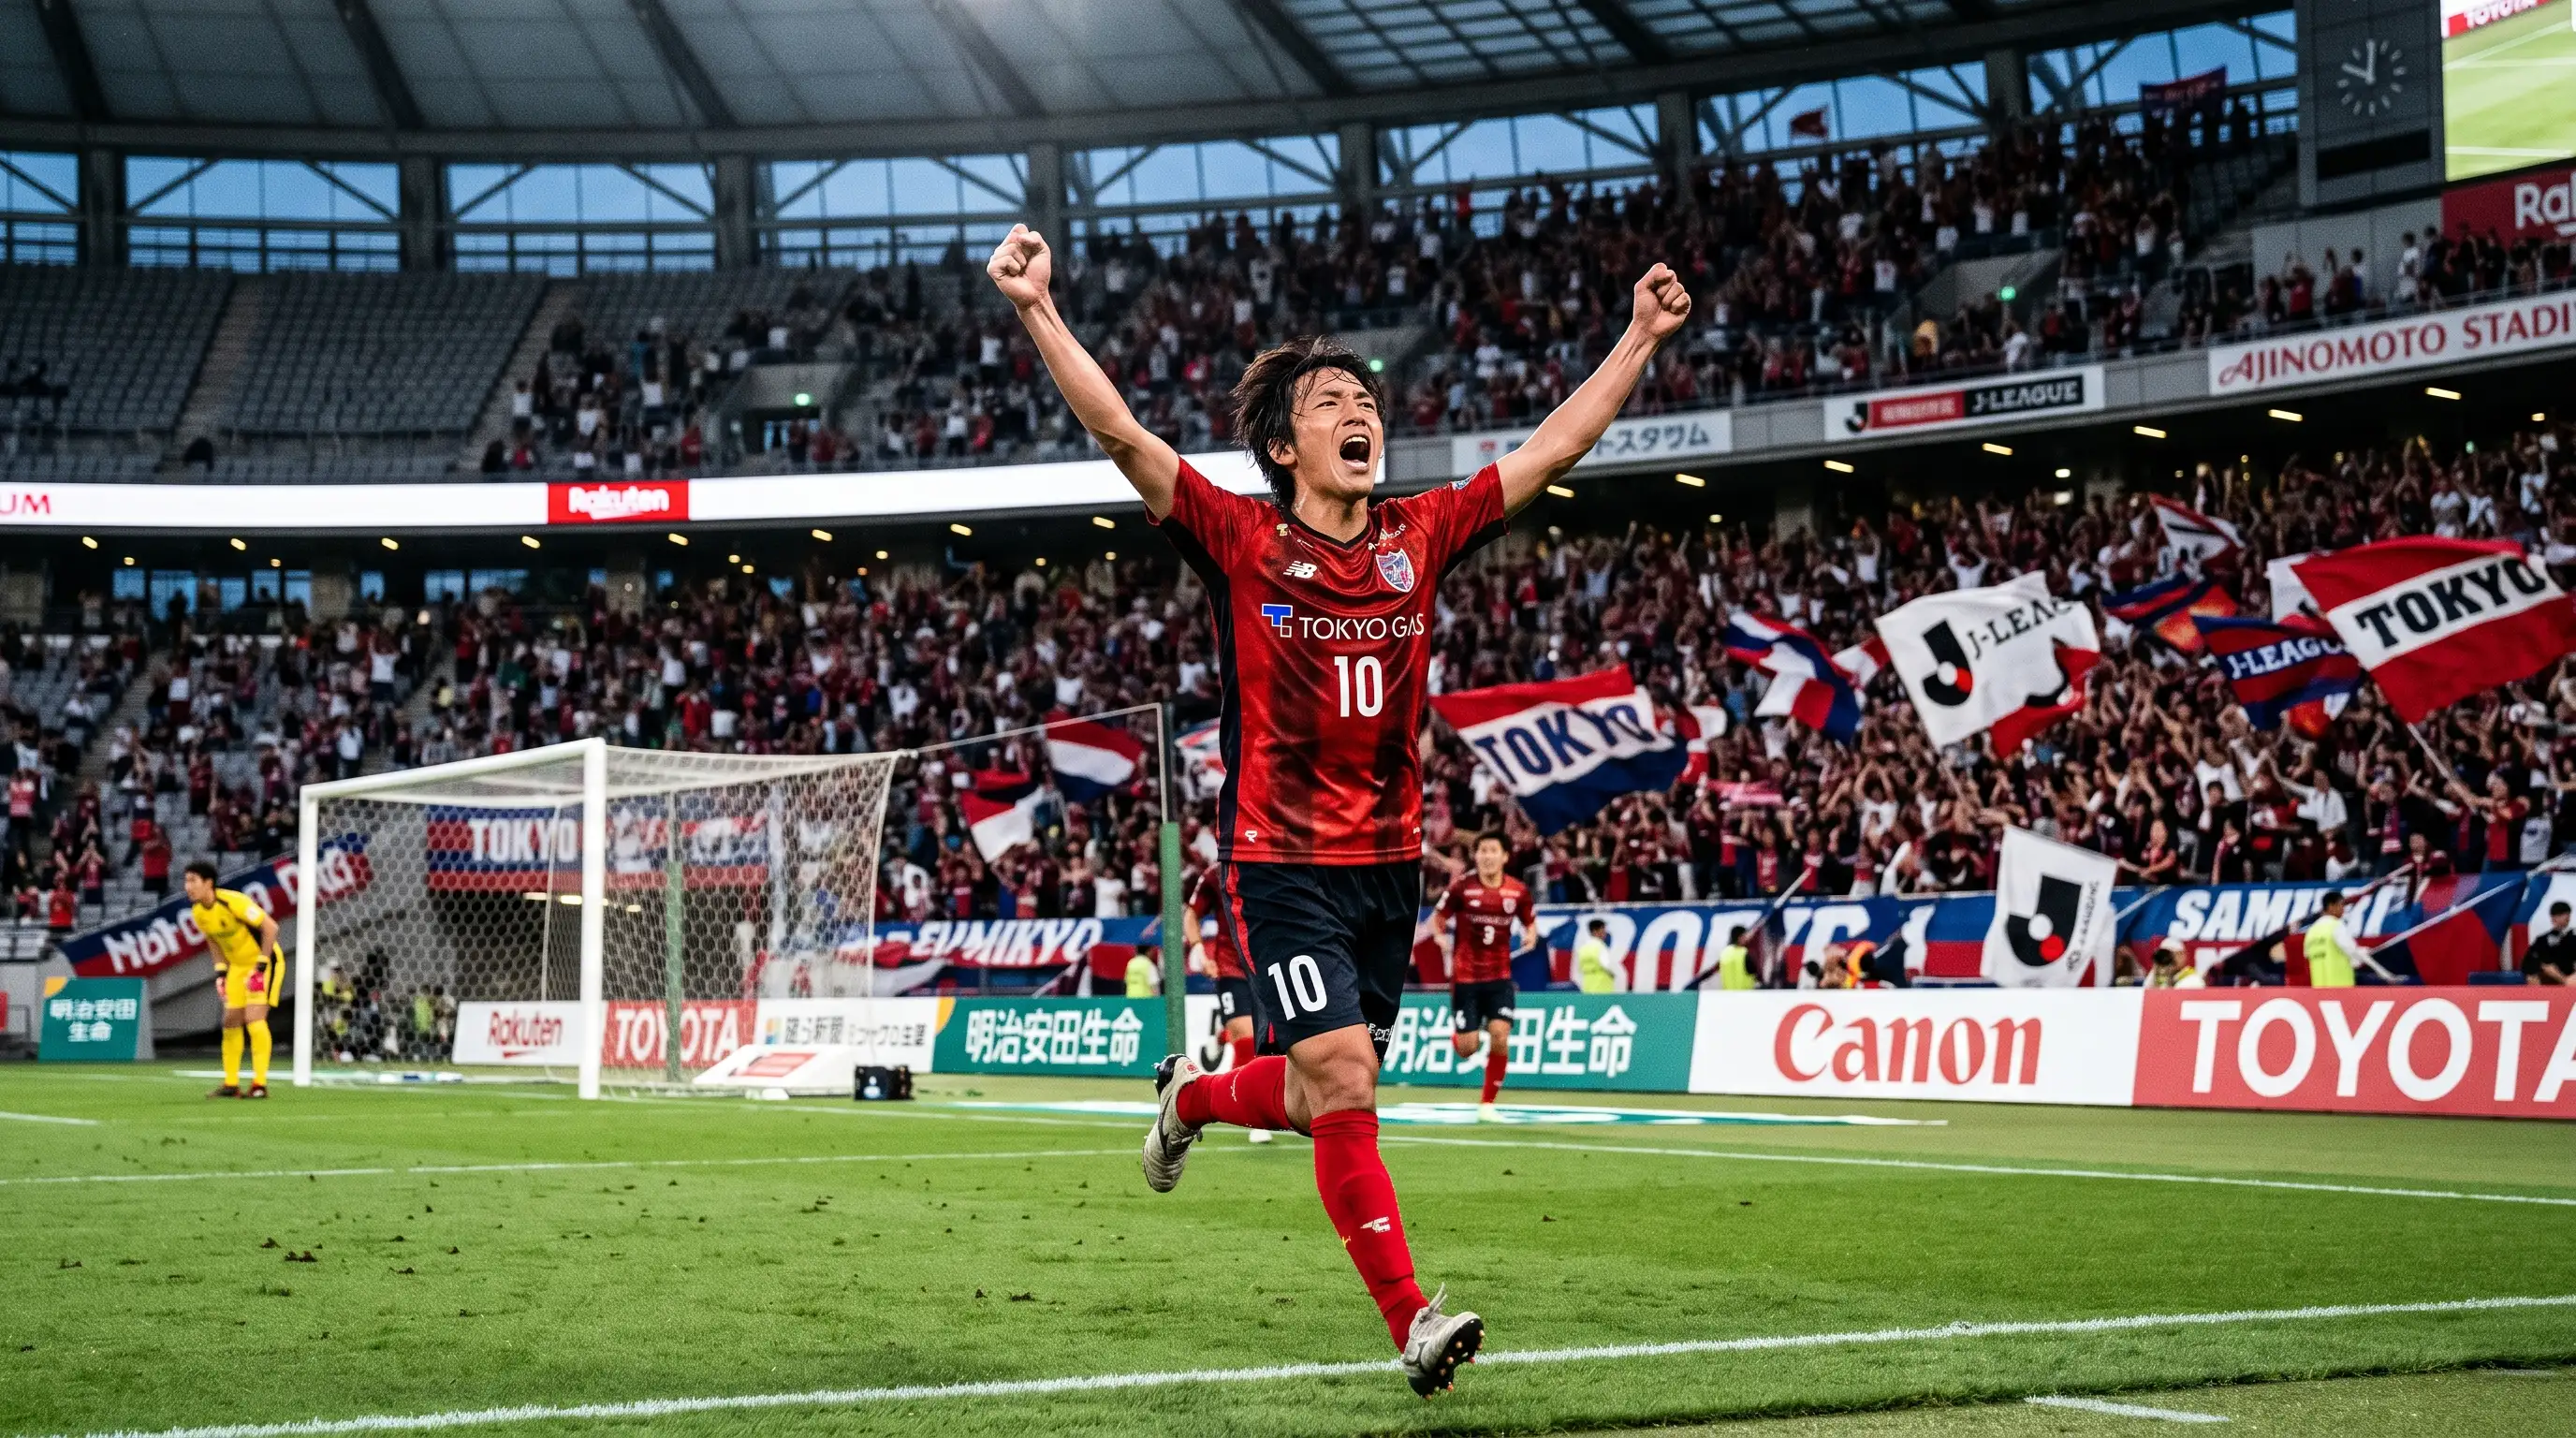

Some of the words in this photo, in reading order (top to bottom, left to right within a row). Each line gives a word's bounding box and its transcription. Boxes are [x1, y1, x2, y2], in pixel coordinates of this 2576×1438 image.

[2514, 170, 2576, 230] Ra
[2218, 322, 2447, 387] AJINOMOTO
[568, 485, 670, 514] Rakuten
[1298, 616, 1387, 640] TOKYO
[1391, 613, 1425, 638] GAS
[2353, 559, 2548, 649] TOKYO
[1334, 655, 1383, 717] 10
[1473, 703, 1655, 785] TOKYO
[471, 811, 576, 863] TOKYO
[1482, 925, 1496, 946] 3
[1221, 990, 1236, 1016] 9
[1267, 954, 1328, 1021] 10
[488, 1008, 563, 1047] Rakuten
[614, 1007, 739, 1063] TOYOTA
[965, 1006, 1143, 1067] 明治安田生命
[1774, 1003, 2043, 1086] Canon
